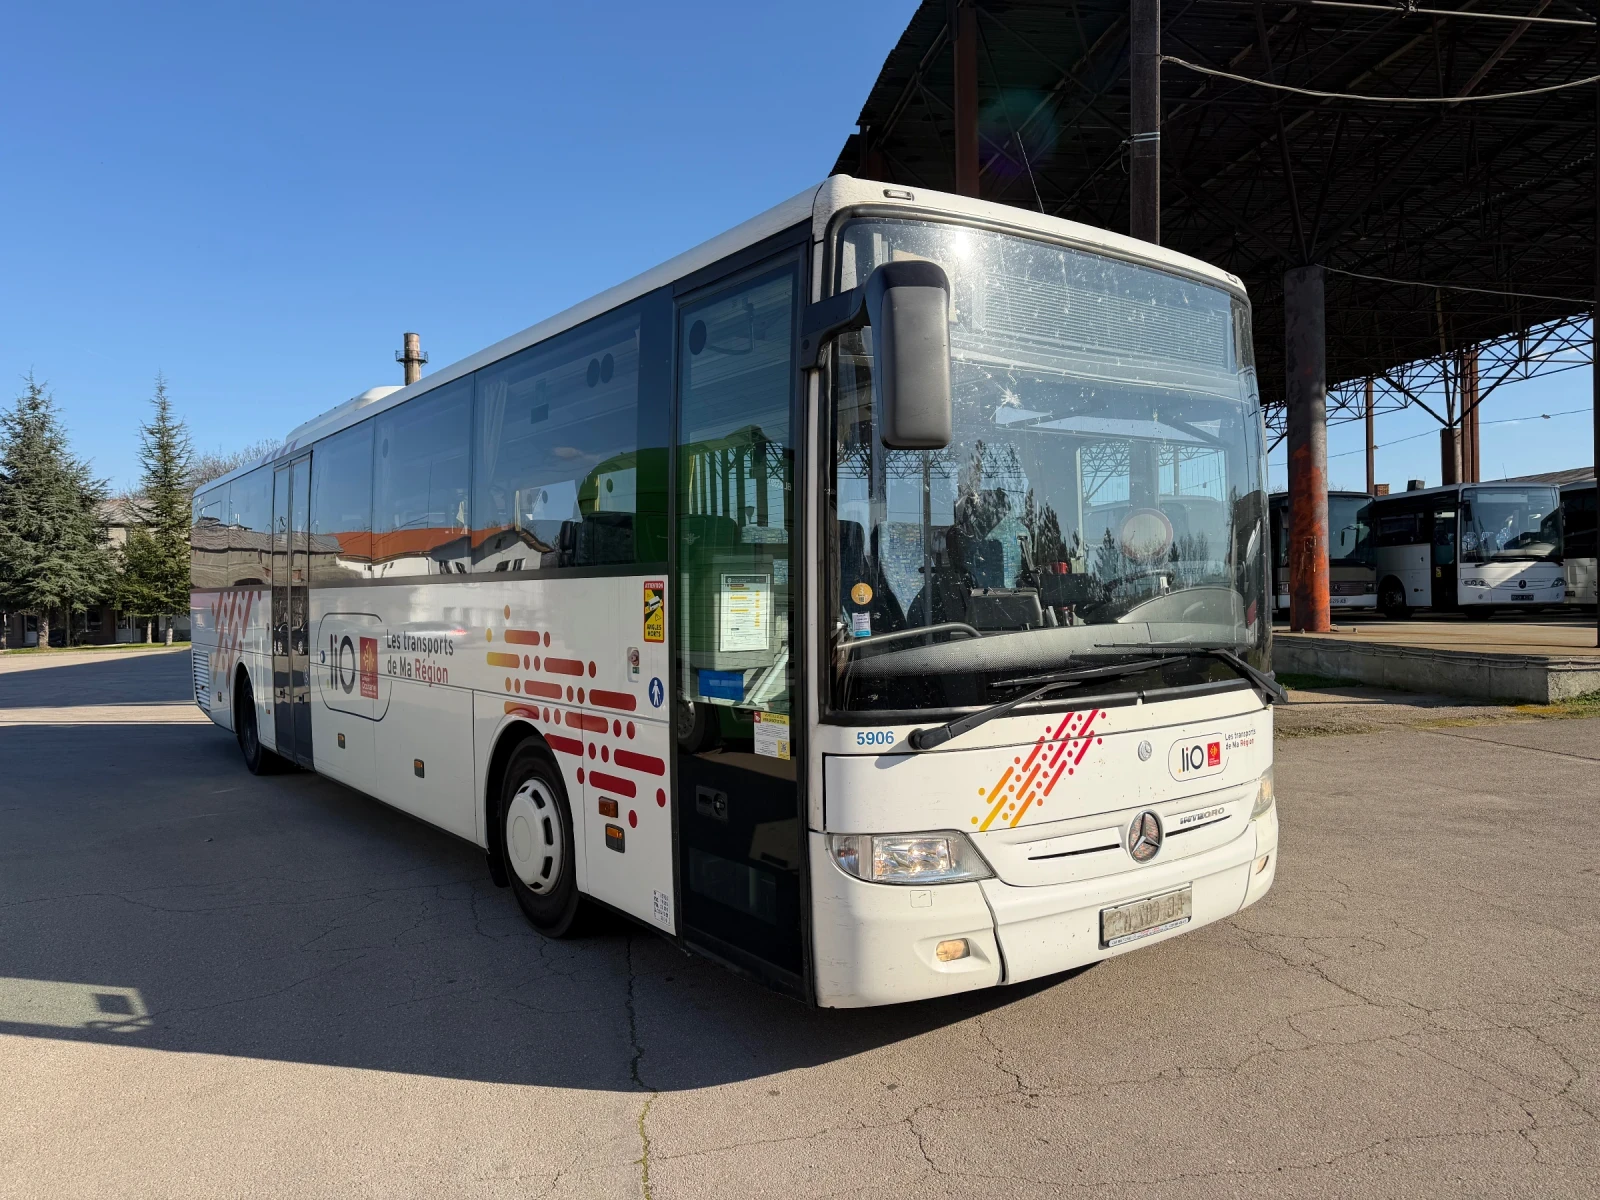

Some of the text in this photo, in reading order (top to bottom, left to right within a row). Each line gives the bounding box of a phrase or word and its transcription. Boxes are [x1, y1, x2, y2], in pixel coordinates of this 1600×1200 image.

[386, 629, 454, 658] Les transports
[387, 655, 449, 687] de Ma Région
[856, 731, 895, 746] 5906
[1224, 728, 1256, 741] Les transports
[1225, 738, 1254, 750] de Ma Région
